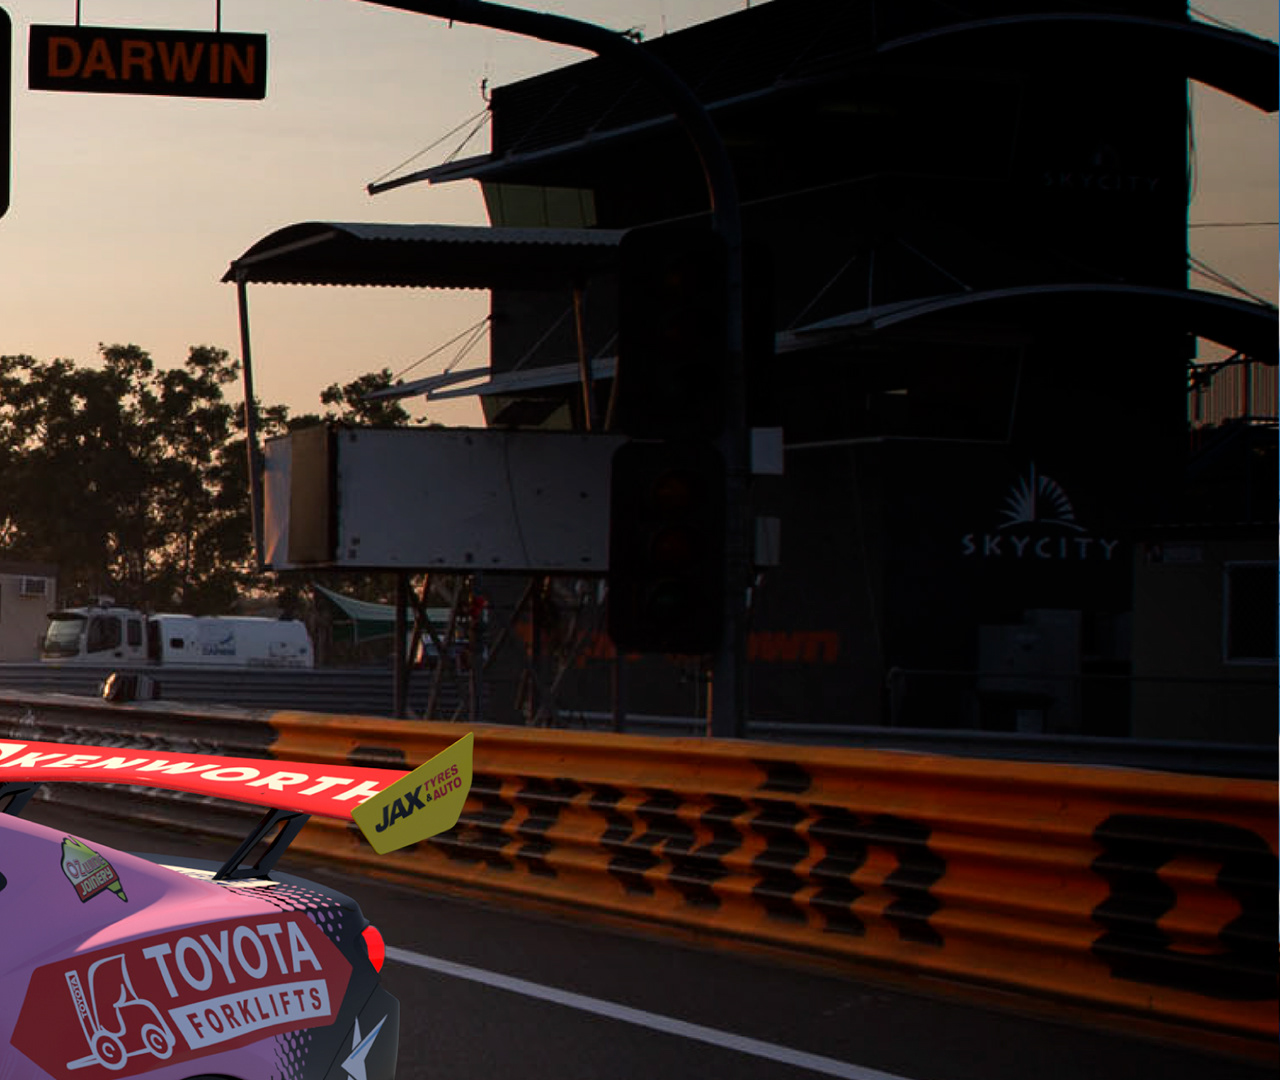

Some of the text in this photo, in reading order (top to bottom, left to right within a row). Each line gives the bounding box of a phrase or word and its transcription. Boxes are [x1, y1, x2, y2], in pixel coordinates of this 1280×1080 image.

[46, 36, 255, 84] DARWIN
[961, 533, 1120, 560] SKYCITY
[4, 751, 380, 804] KENWORTH
[423, 763, 459, 791] TYRES
[426, 776, 462, 802] & AUTO
[375, 784, 426, 833] JAX
[80, 866, 114, 896] JOINERY
[142, 920, 323, 999] TOYOTA
[70, 975, 88, 1020] TOYOTA
[186, 988, 323, 1040] FORKLIFTS
